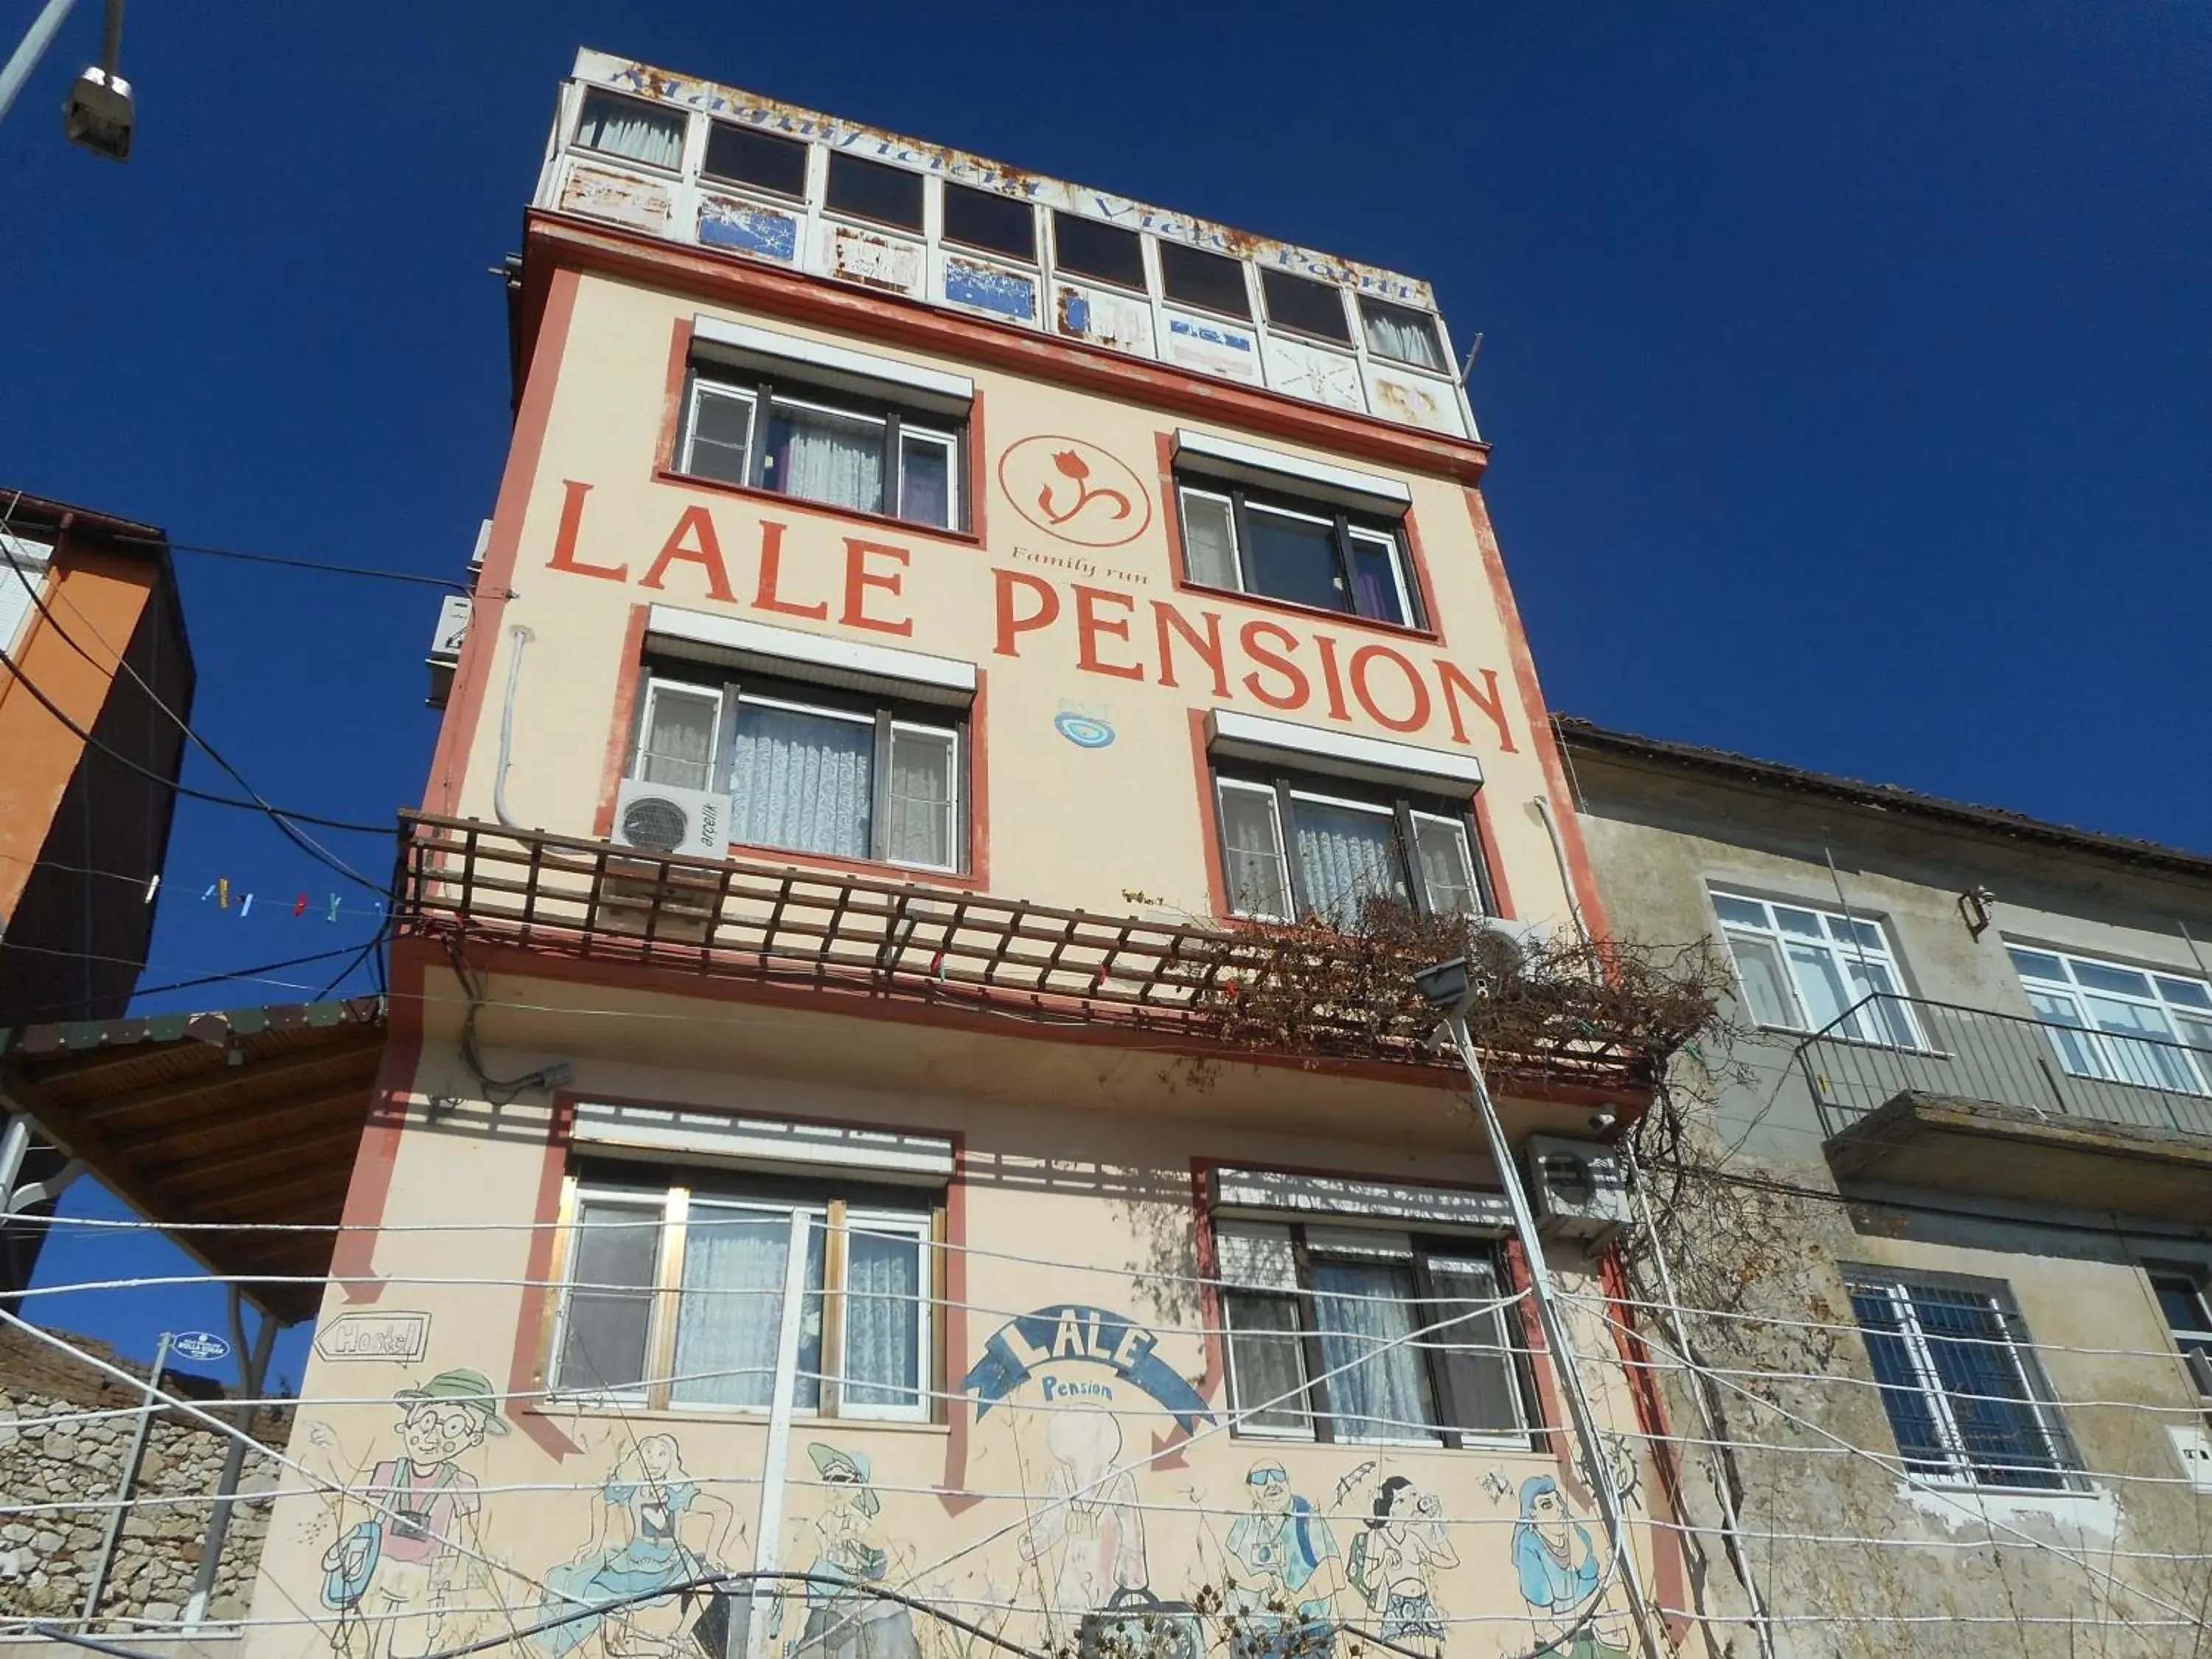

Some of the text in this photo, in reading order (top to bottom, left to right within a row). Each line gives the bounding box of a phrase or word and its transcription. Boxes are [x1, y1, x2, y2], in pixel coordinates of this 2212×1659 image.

[1012, 546, 1150, 585] Family run
[545, 478, 1519, 754] LALE PENSION
[1000, 1308, 1152, 1368] LALE
[1041, 1375, 1113, 1402] Pension
